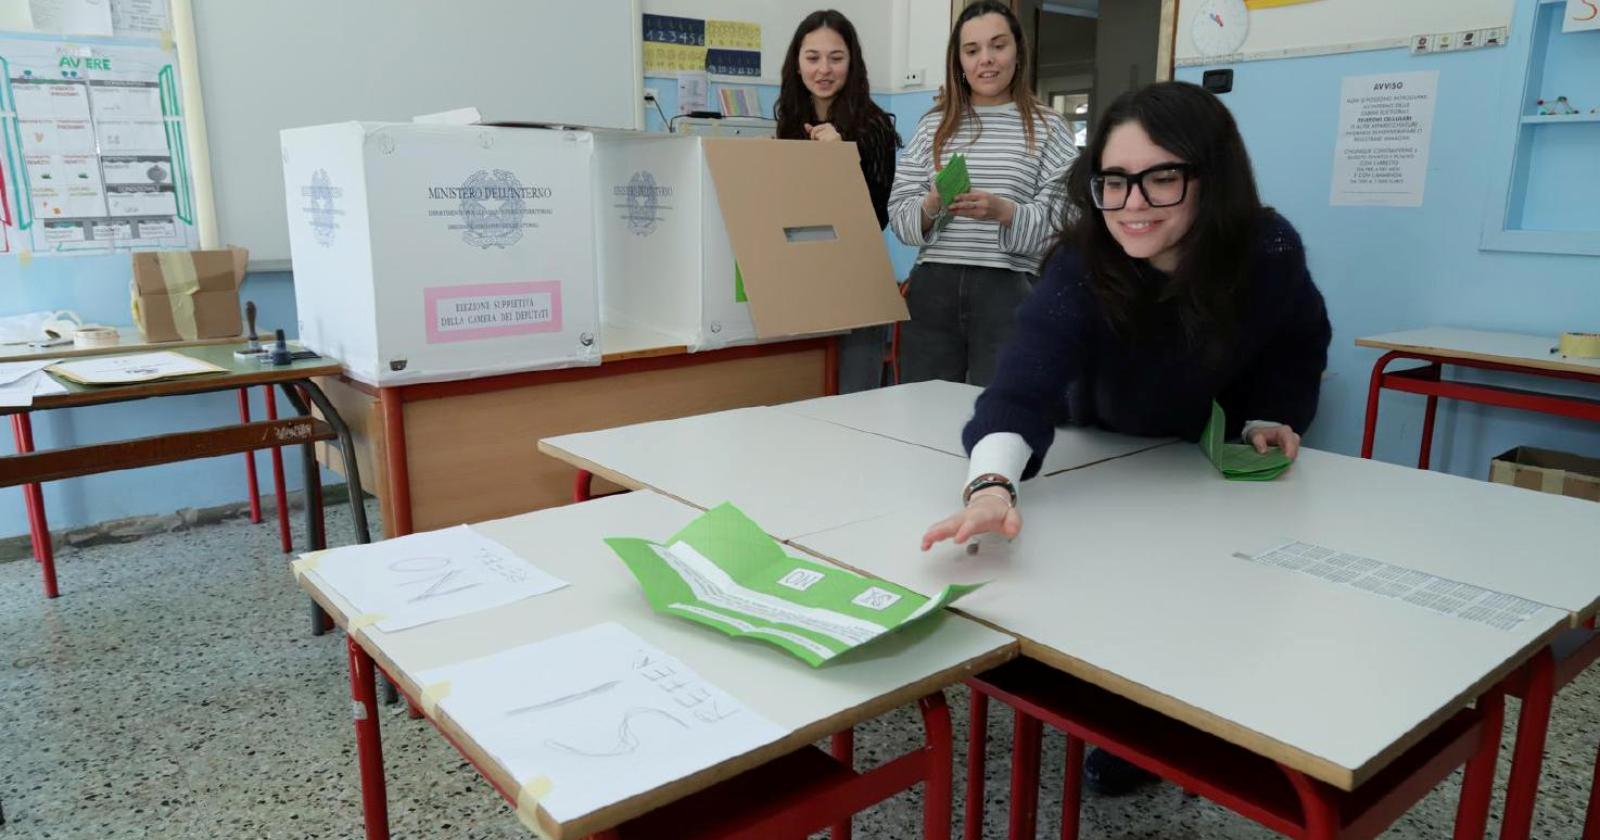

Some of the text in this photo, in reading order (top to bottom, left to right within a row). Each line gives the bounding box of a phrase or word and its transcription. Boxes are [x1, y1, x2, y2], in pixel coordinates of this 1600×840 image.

[658, 31, 666, 41] 2
[669, 32, 677, 42] 3
[679, 31, 687, 43] 4
[689, 33, 695, 44] 5
[1373, 81, 1403, 91] AVVISO
[428, 187, 552, 199] MINISTERO DELL'INTERNO
[456, 301, 490, 312] ELEZIONE
[441, 309, 549, 327] DELLA CAMERA DEI DEPUTATI
